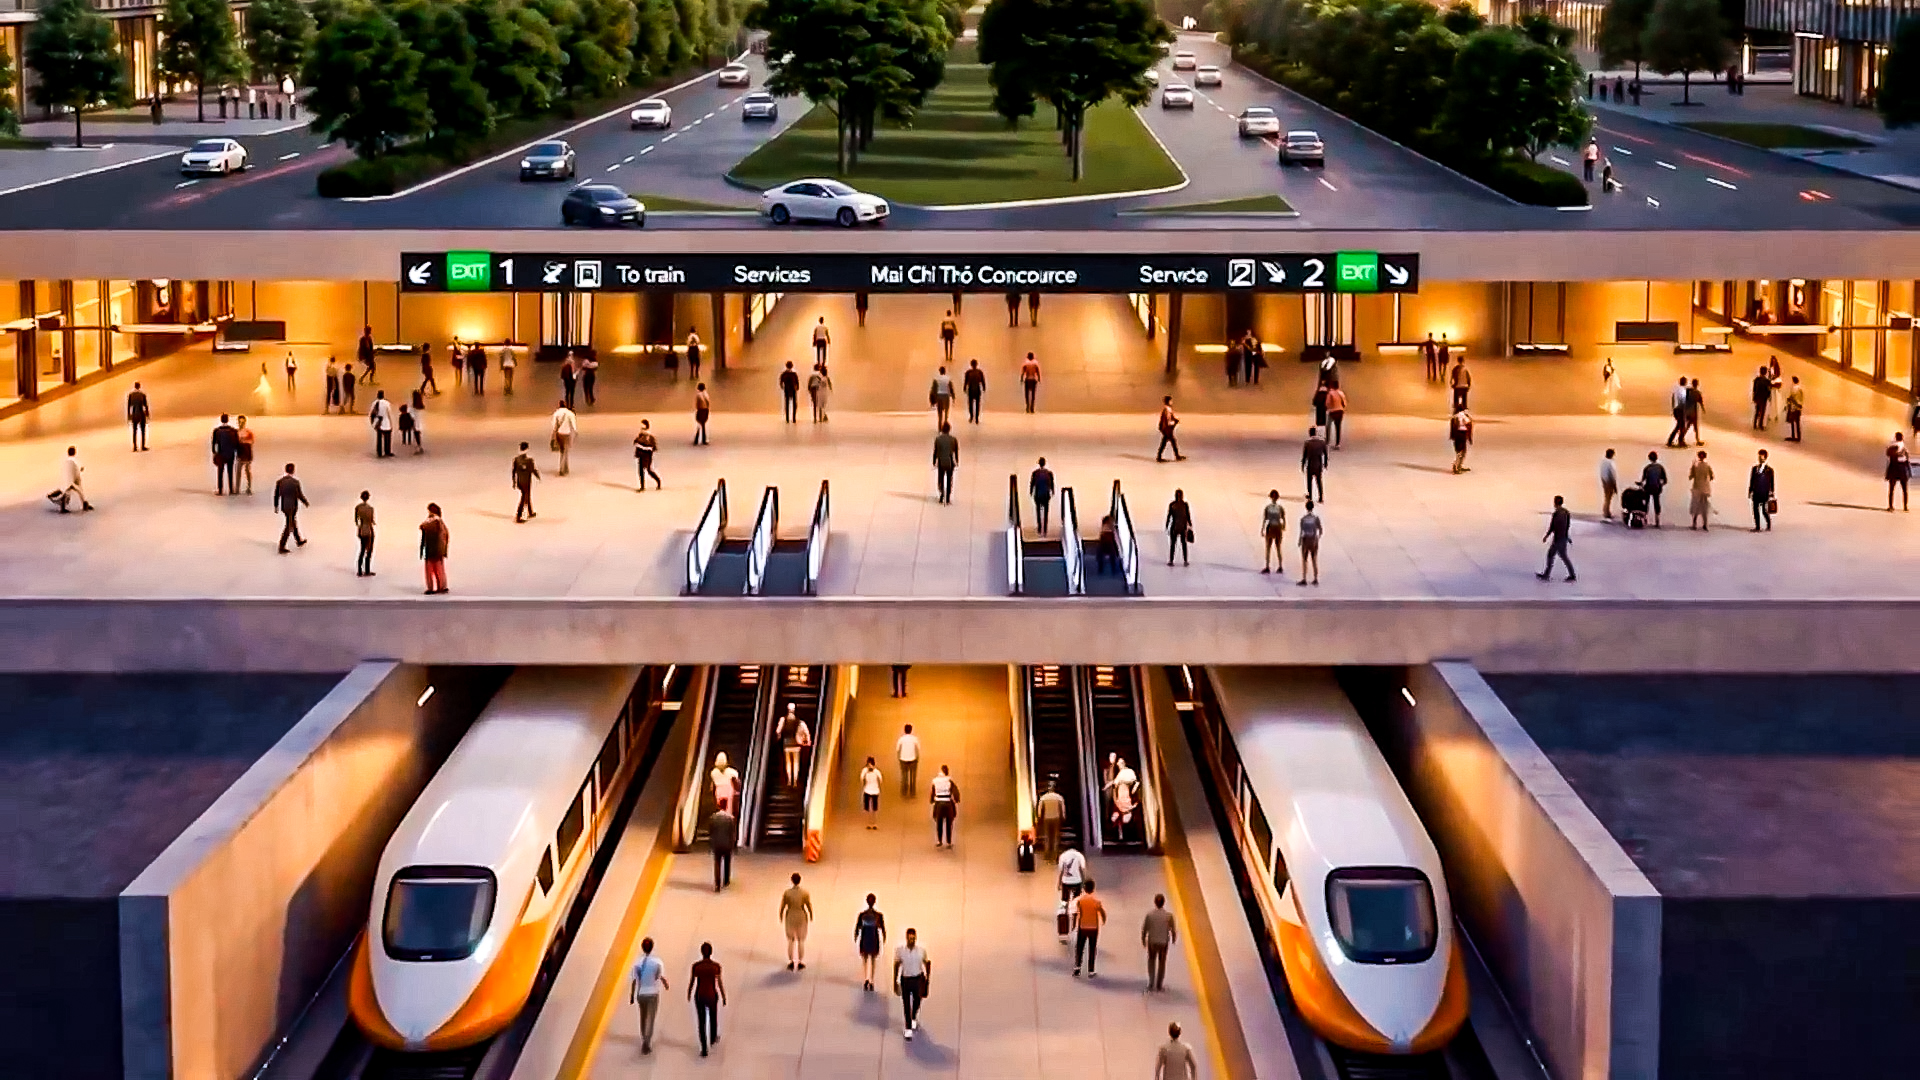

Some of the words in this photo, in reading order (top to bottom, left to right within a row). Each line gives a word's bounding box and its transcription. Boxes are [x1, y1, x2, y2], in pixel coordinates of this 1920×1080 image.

[452, 264, 487, 280] EXIT
[499, 259, 514, 285] 1
[616, 265, 641, 284] To
[644, 265, 686, 284] train
[734, 265, 811, 283] Services
[871, 265, 904, 284] Mai
[1303, 259, 1325, 287] 2
